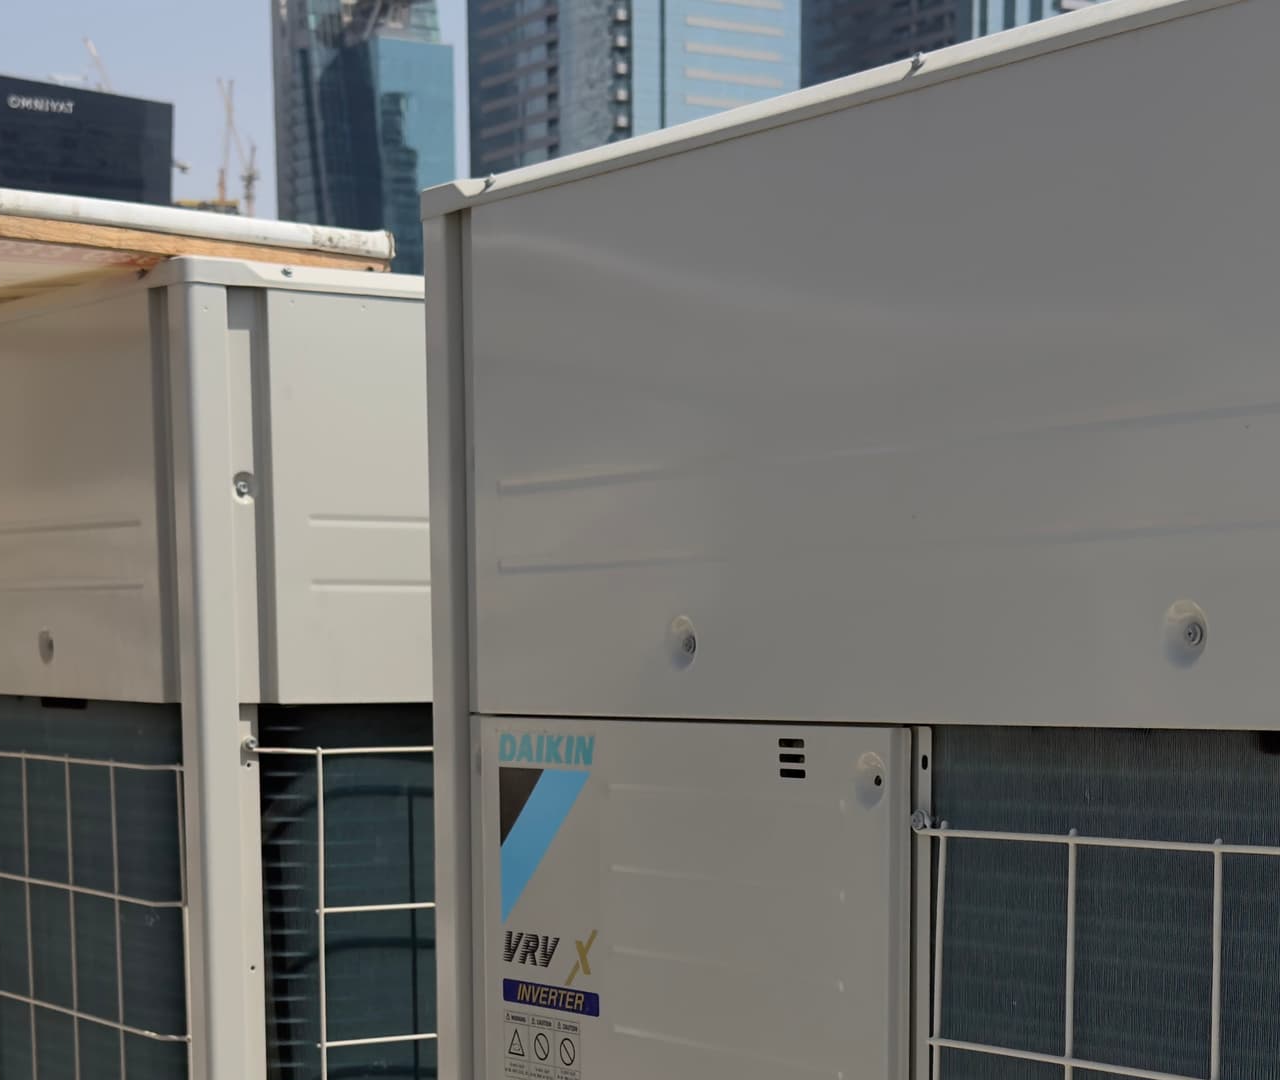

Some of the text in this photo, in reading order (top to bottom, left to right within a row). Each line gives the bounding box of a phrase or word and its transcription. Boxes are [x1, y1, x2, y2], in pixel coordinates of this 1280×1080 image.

[7, 95, 74, 113] OMNIYAT
[499, 733, 595, 765] DAIKIN
[503, 930, 560, 968] VRV
[517, 983, 585, 1011] INVERTER
